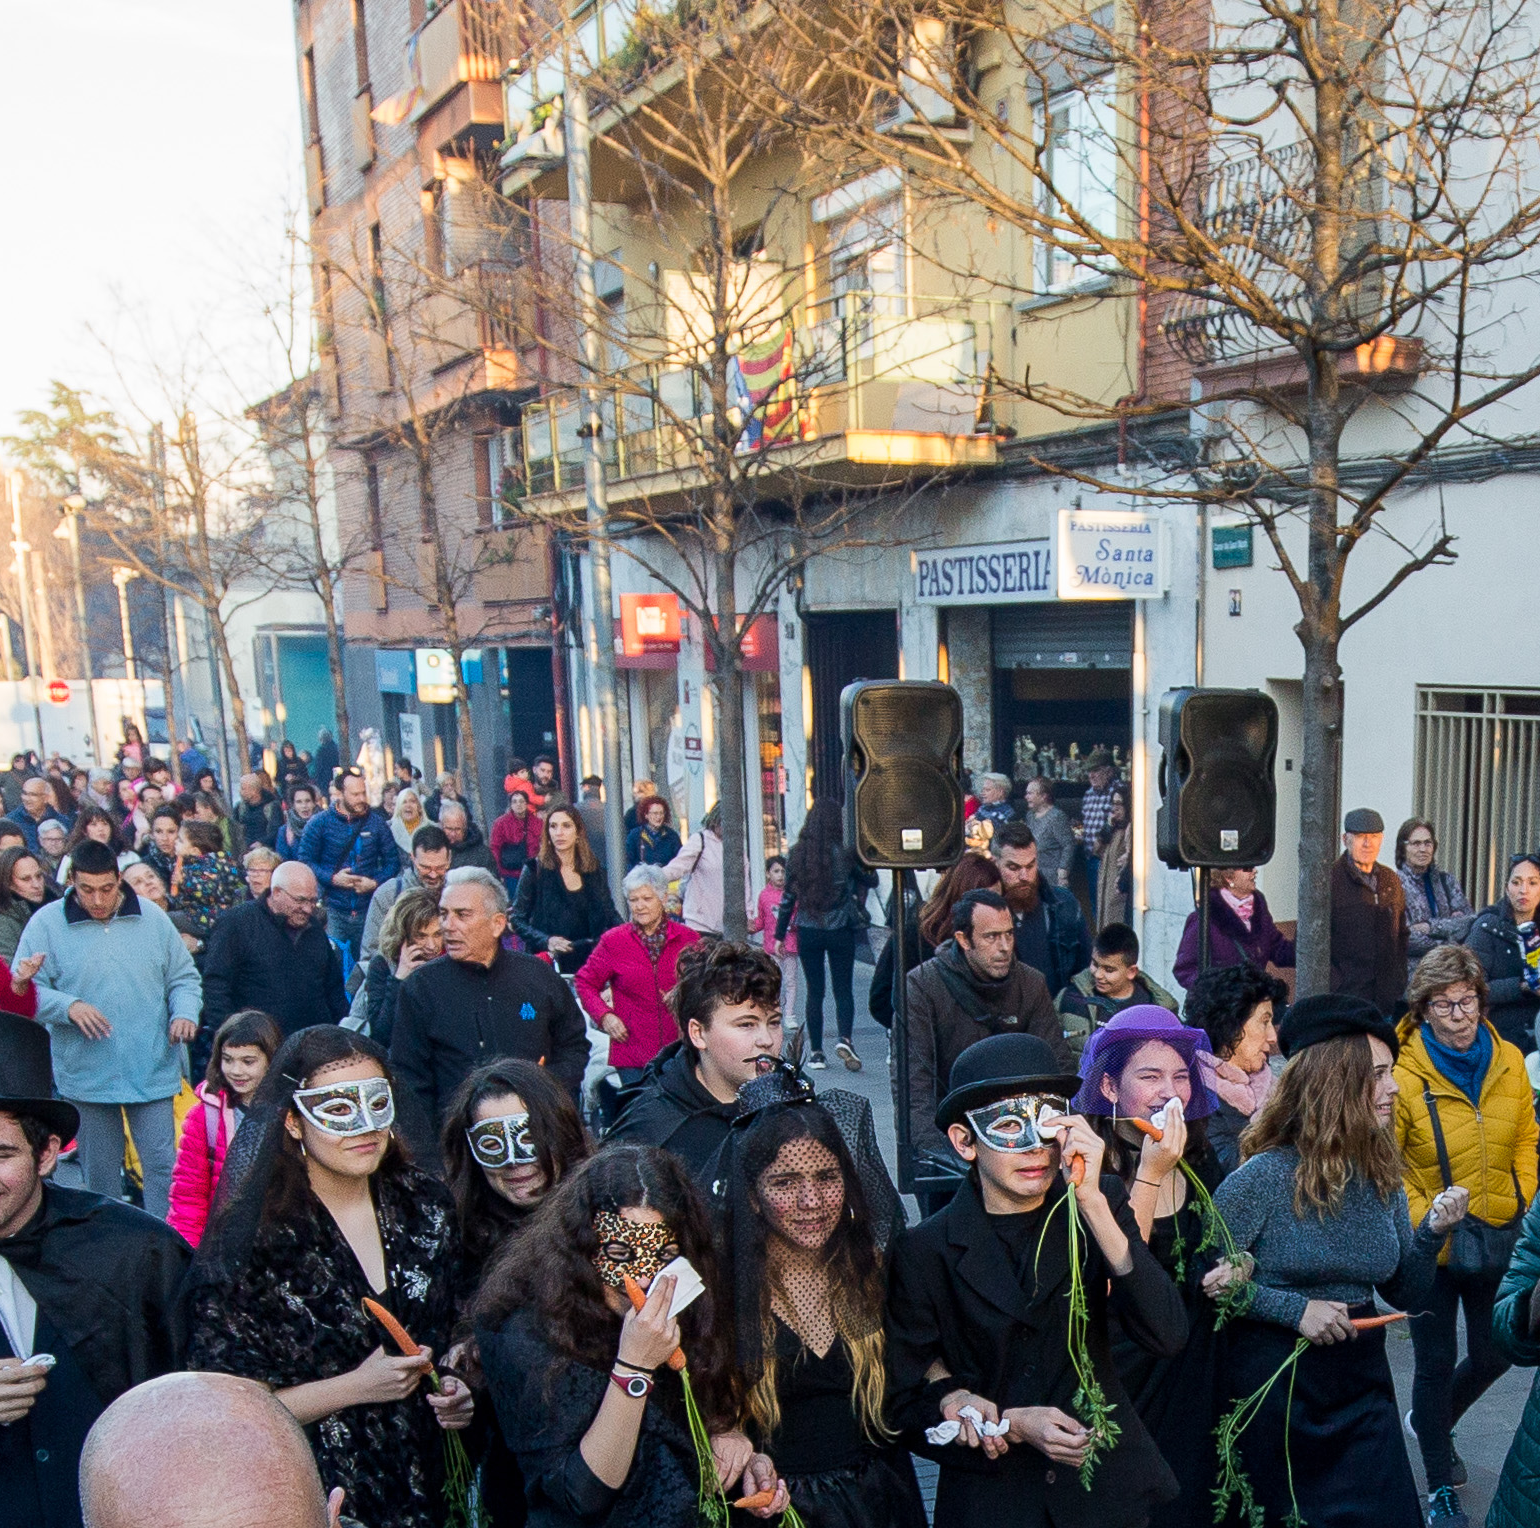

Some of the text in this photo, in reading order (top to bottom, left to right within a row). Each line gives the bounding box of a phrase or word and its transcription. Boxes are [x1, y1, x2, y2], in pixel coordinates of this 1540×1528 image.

[1070, 520, 1151, 534] PASTISSERIA
[1096, 539, 1153, 563] Santa
[1072, 565, 1154, 590] Mònica
